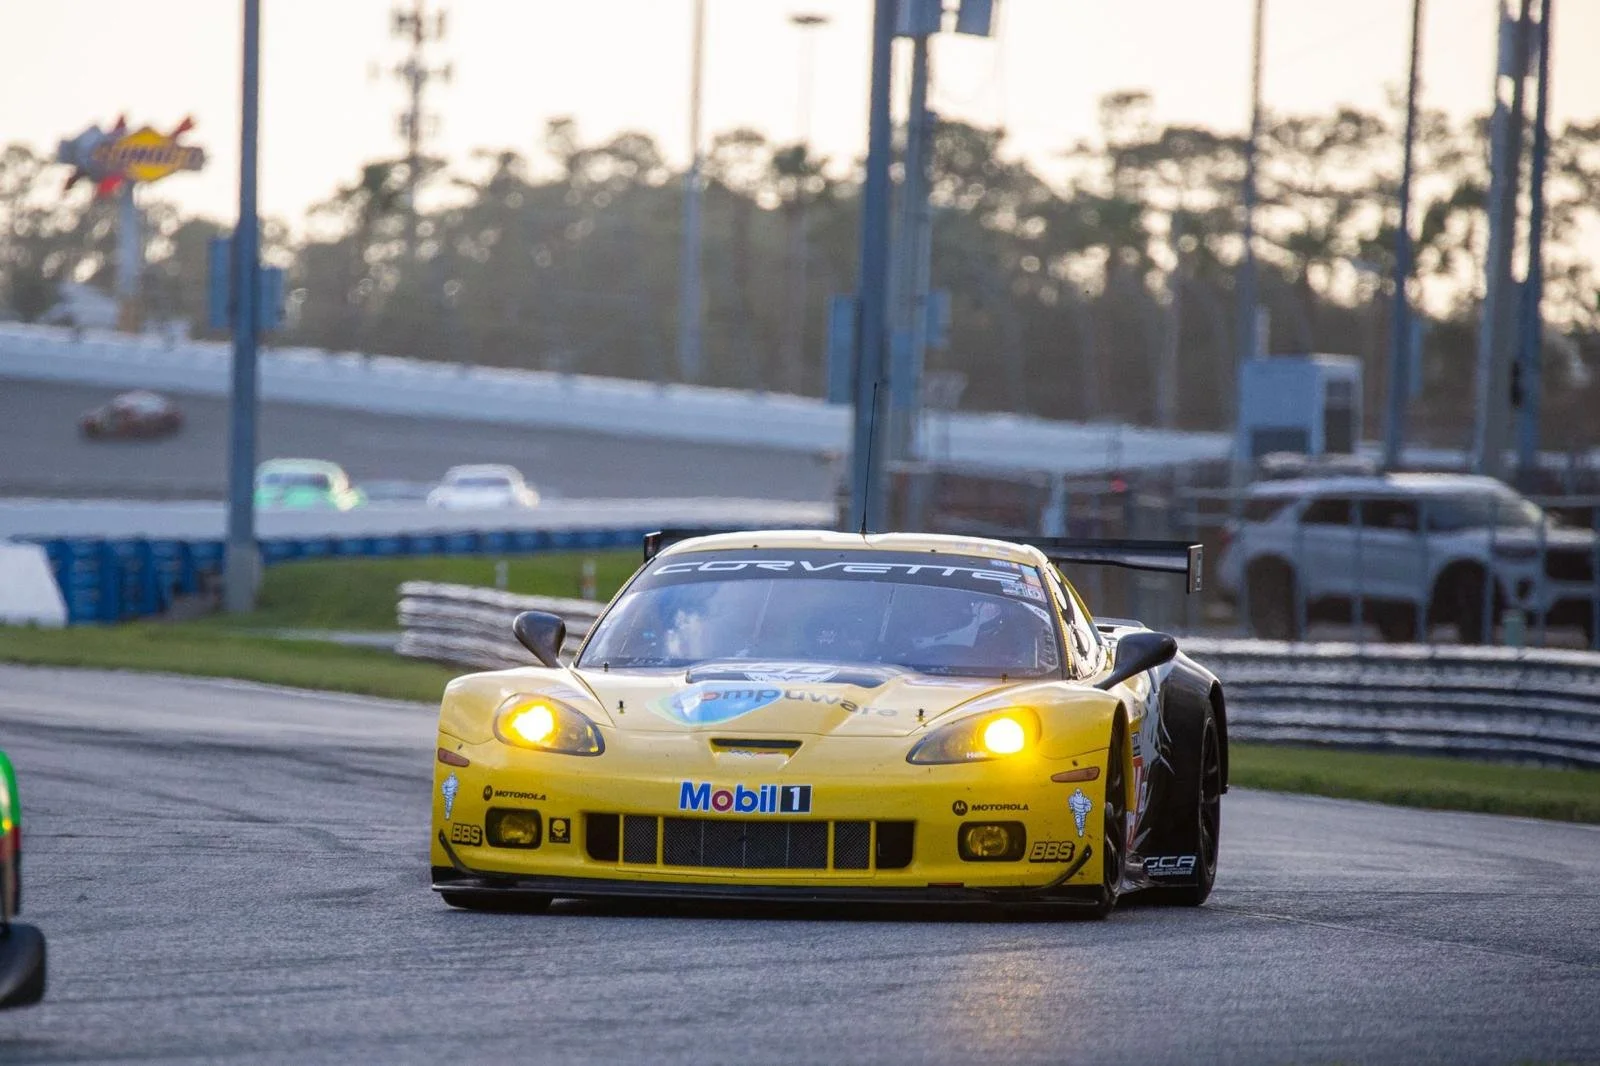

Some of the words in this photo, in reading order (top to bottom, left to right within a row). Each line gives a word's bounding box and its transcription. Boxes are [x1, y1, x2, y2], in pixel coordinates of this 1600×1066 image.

[653, 560, 1022, 583] CORVETTE
[494, 790, 547, 801] MOTOROLA
[680, 781, 777, 812] Mobil
[789, 786, 800, 811] 1
[971, 803, 1029, 812] MOTOROLA
[452, 823, 482, 846] BBS
[1030, 841, 1075, 863] BBS
